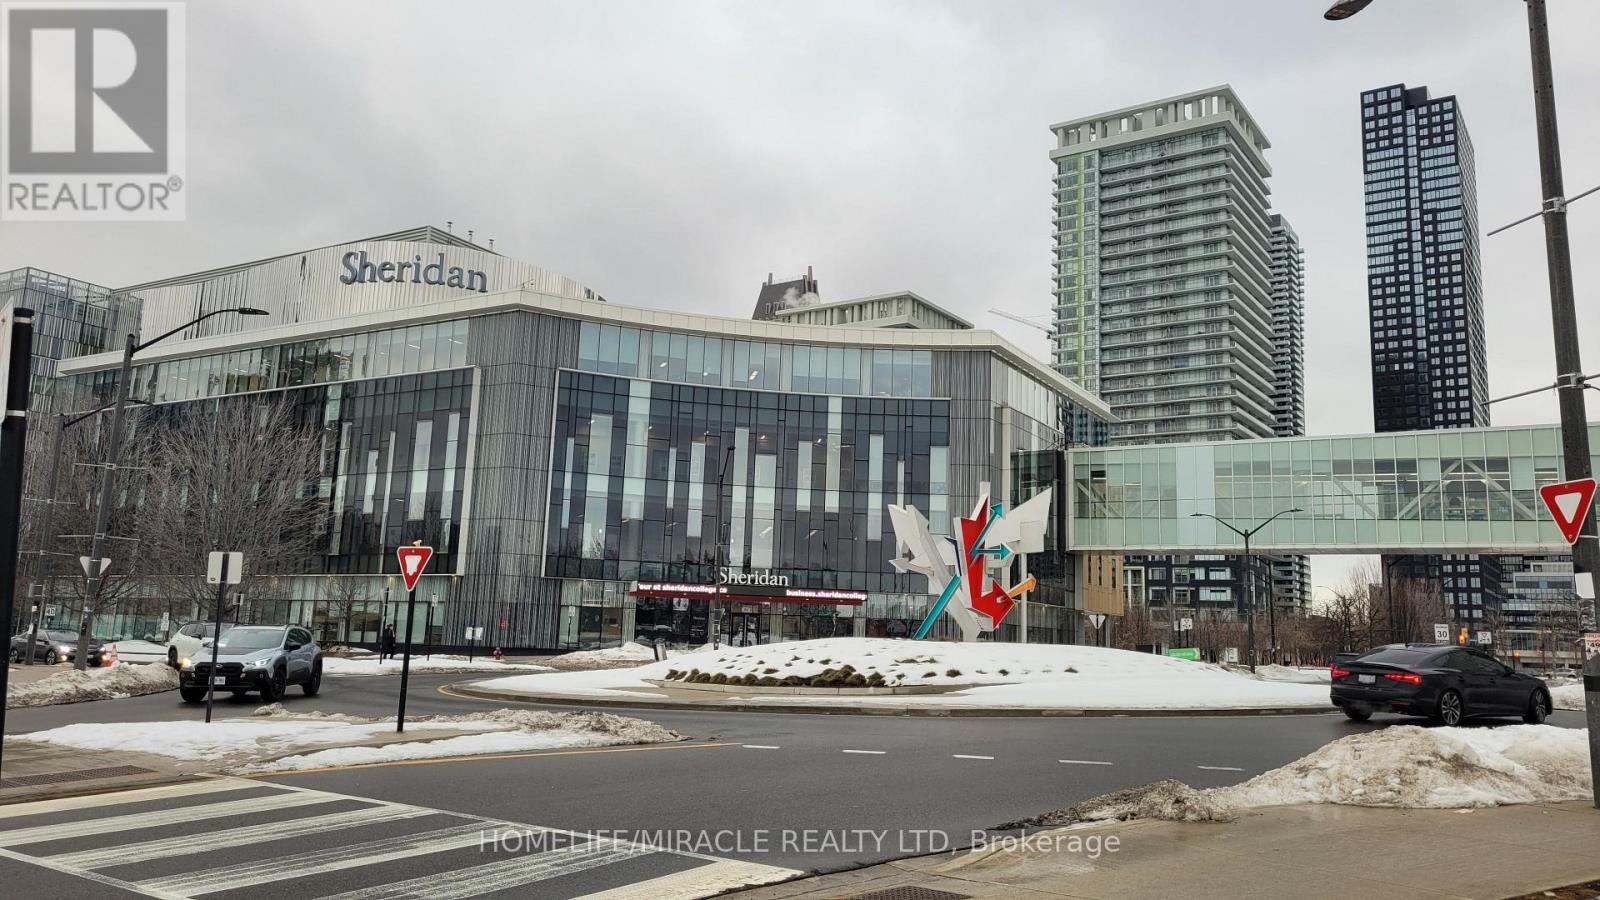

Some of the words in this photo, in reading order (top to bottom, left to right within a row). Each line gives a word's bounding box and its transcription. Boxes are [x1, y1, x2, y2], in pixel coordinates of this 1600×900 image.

[340, 250, 488, 293] Sheridan
[719, 567, 788, 586] Sheridan
[1437, 630, 1447, 638] 30
